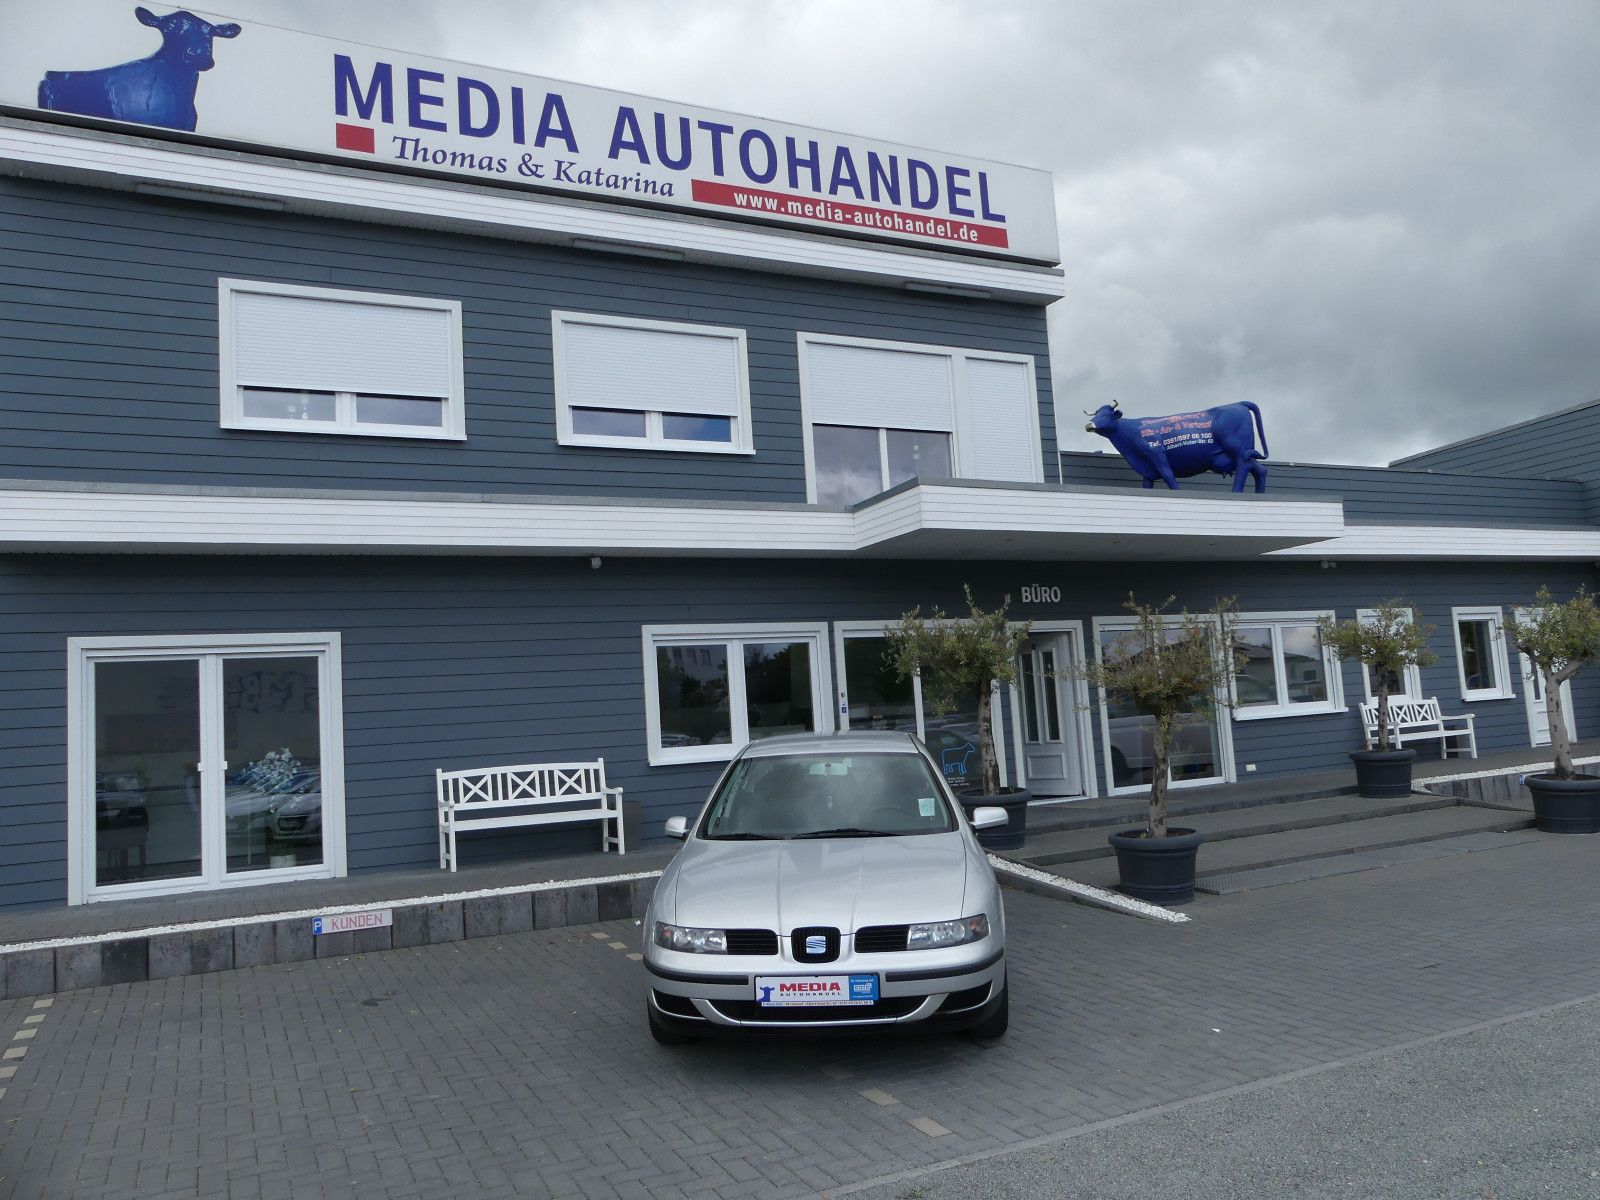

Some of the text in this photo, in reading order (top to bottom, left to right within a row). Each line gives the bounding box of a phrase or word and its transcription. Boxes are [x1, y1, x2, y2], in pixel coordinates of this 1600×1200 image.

[334, 54, 1006, 223] MEDIA AUTOHANDEL
[392, 135, 675, 197] Thomas & Katarina
[733, 192, 978, 242] www.media-autohandel.de
[1021, 583, 1061, 603] BÜRO
[331, 912, 383, 931] KUNDEN
[779, 982, 841, 992] MEDIA
